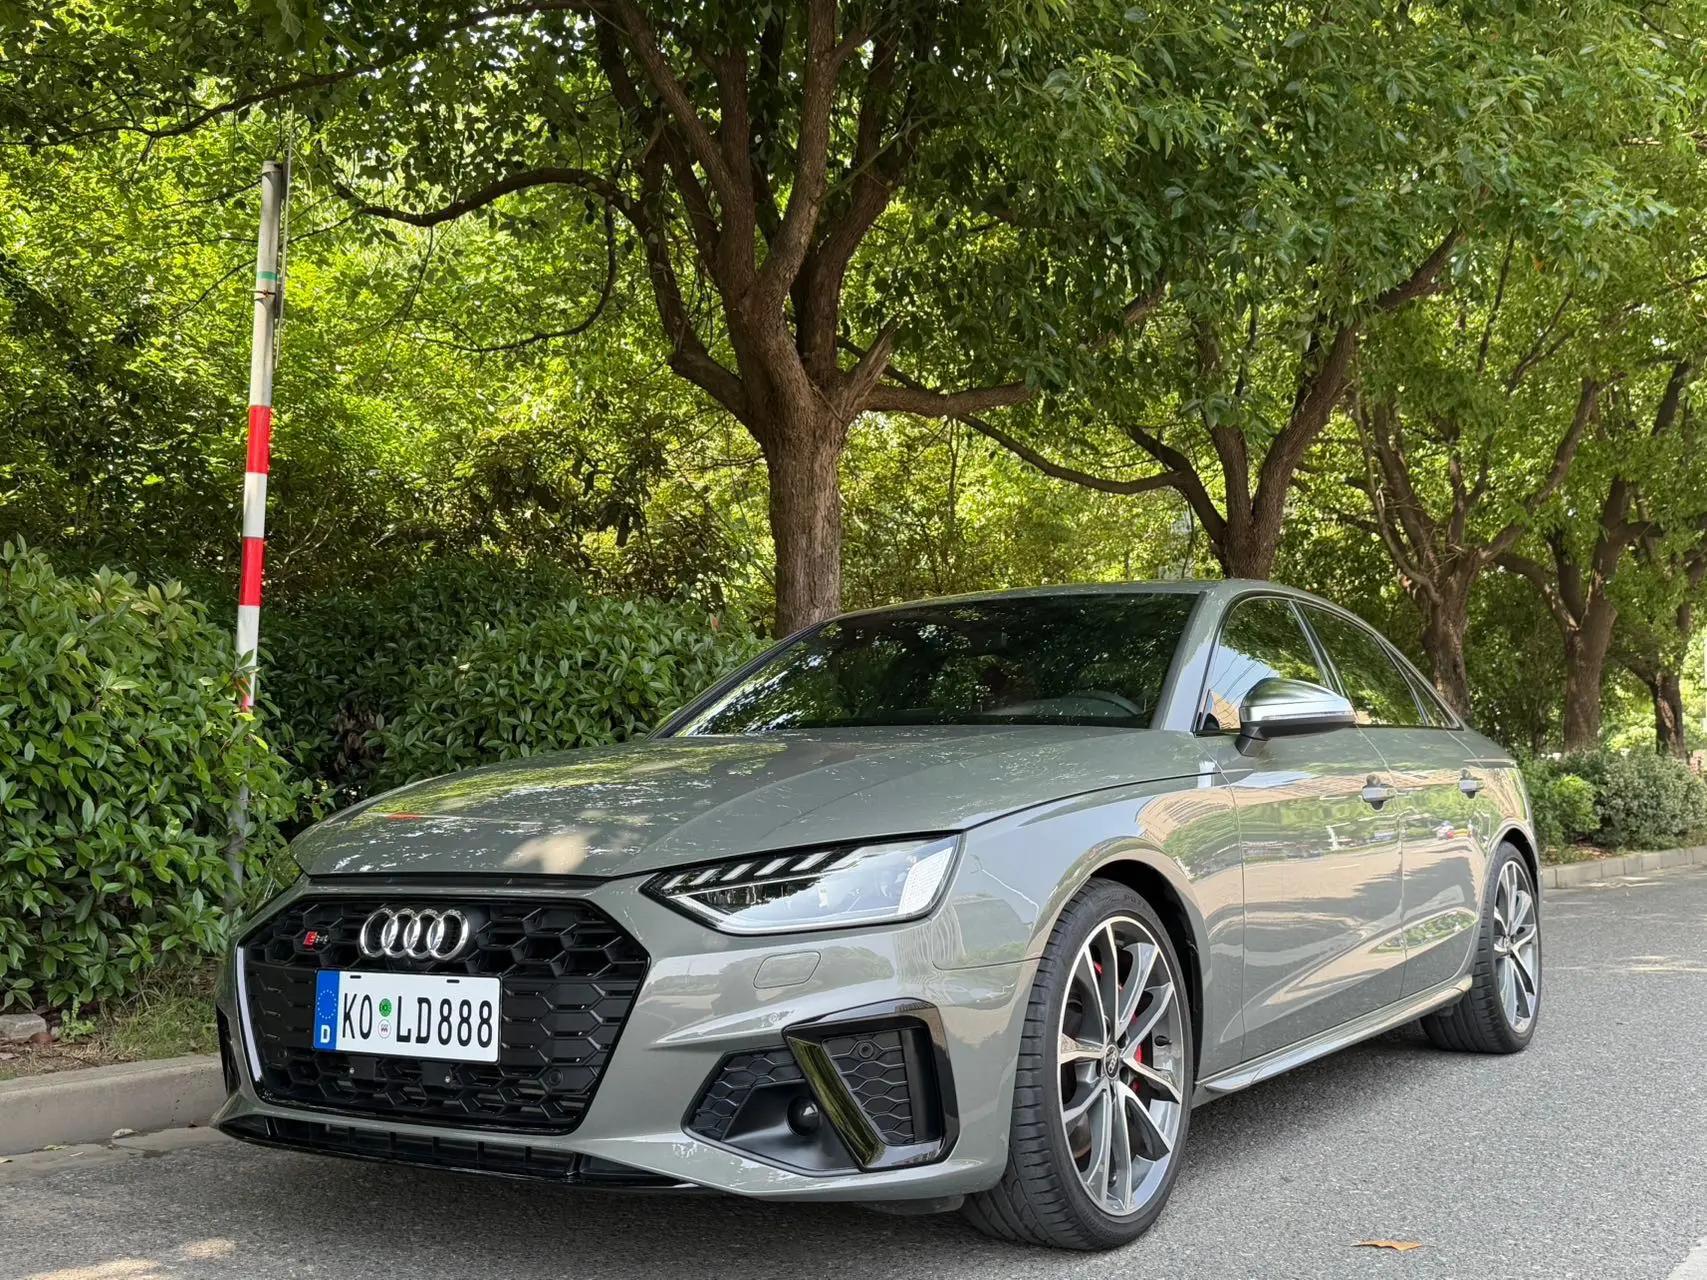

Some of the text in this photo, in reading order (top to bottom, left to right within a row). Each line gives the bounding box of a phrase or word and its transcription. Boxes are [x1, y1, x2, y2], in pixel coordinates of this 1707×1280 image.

[320, 1024, 331, 1043] D
[342, 993, 493, 1048] KO LD888
